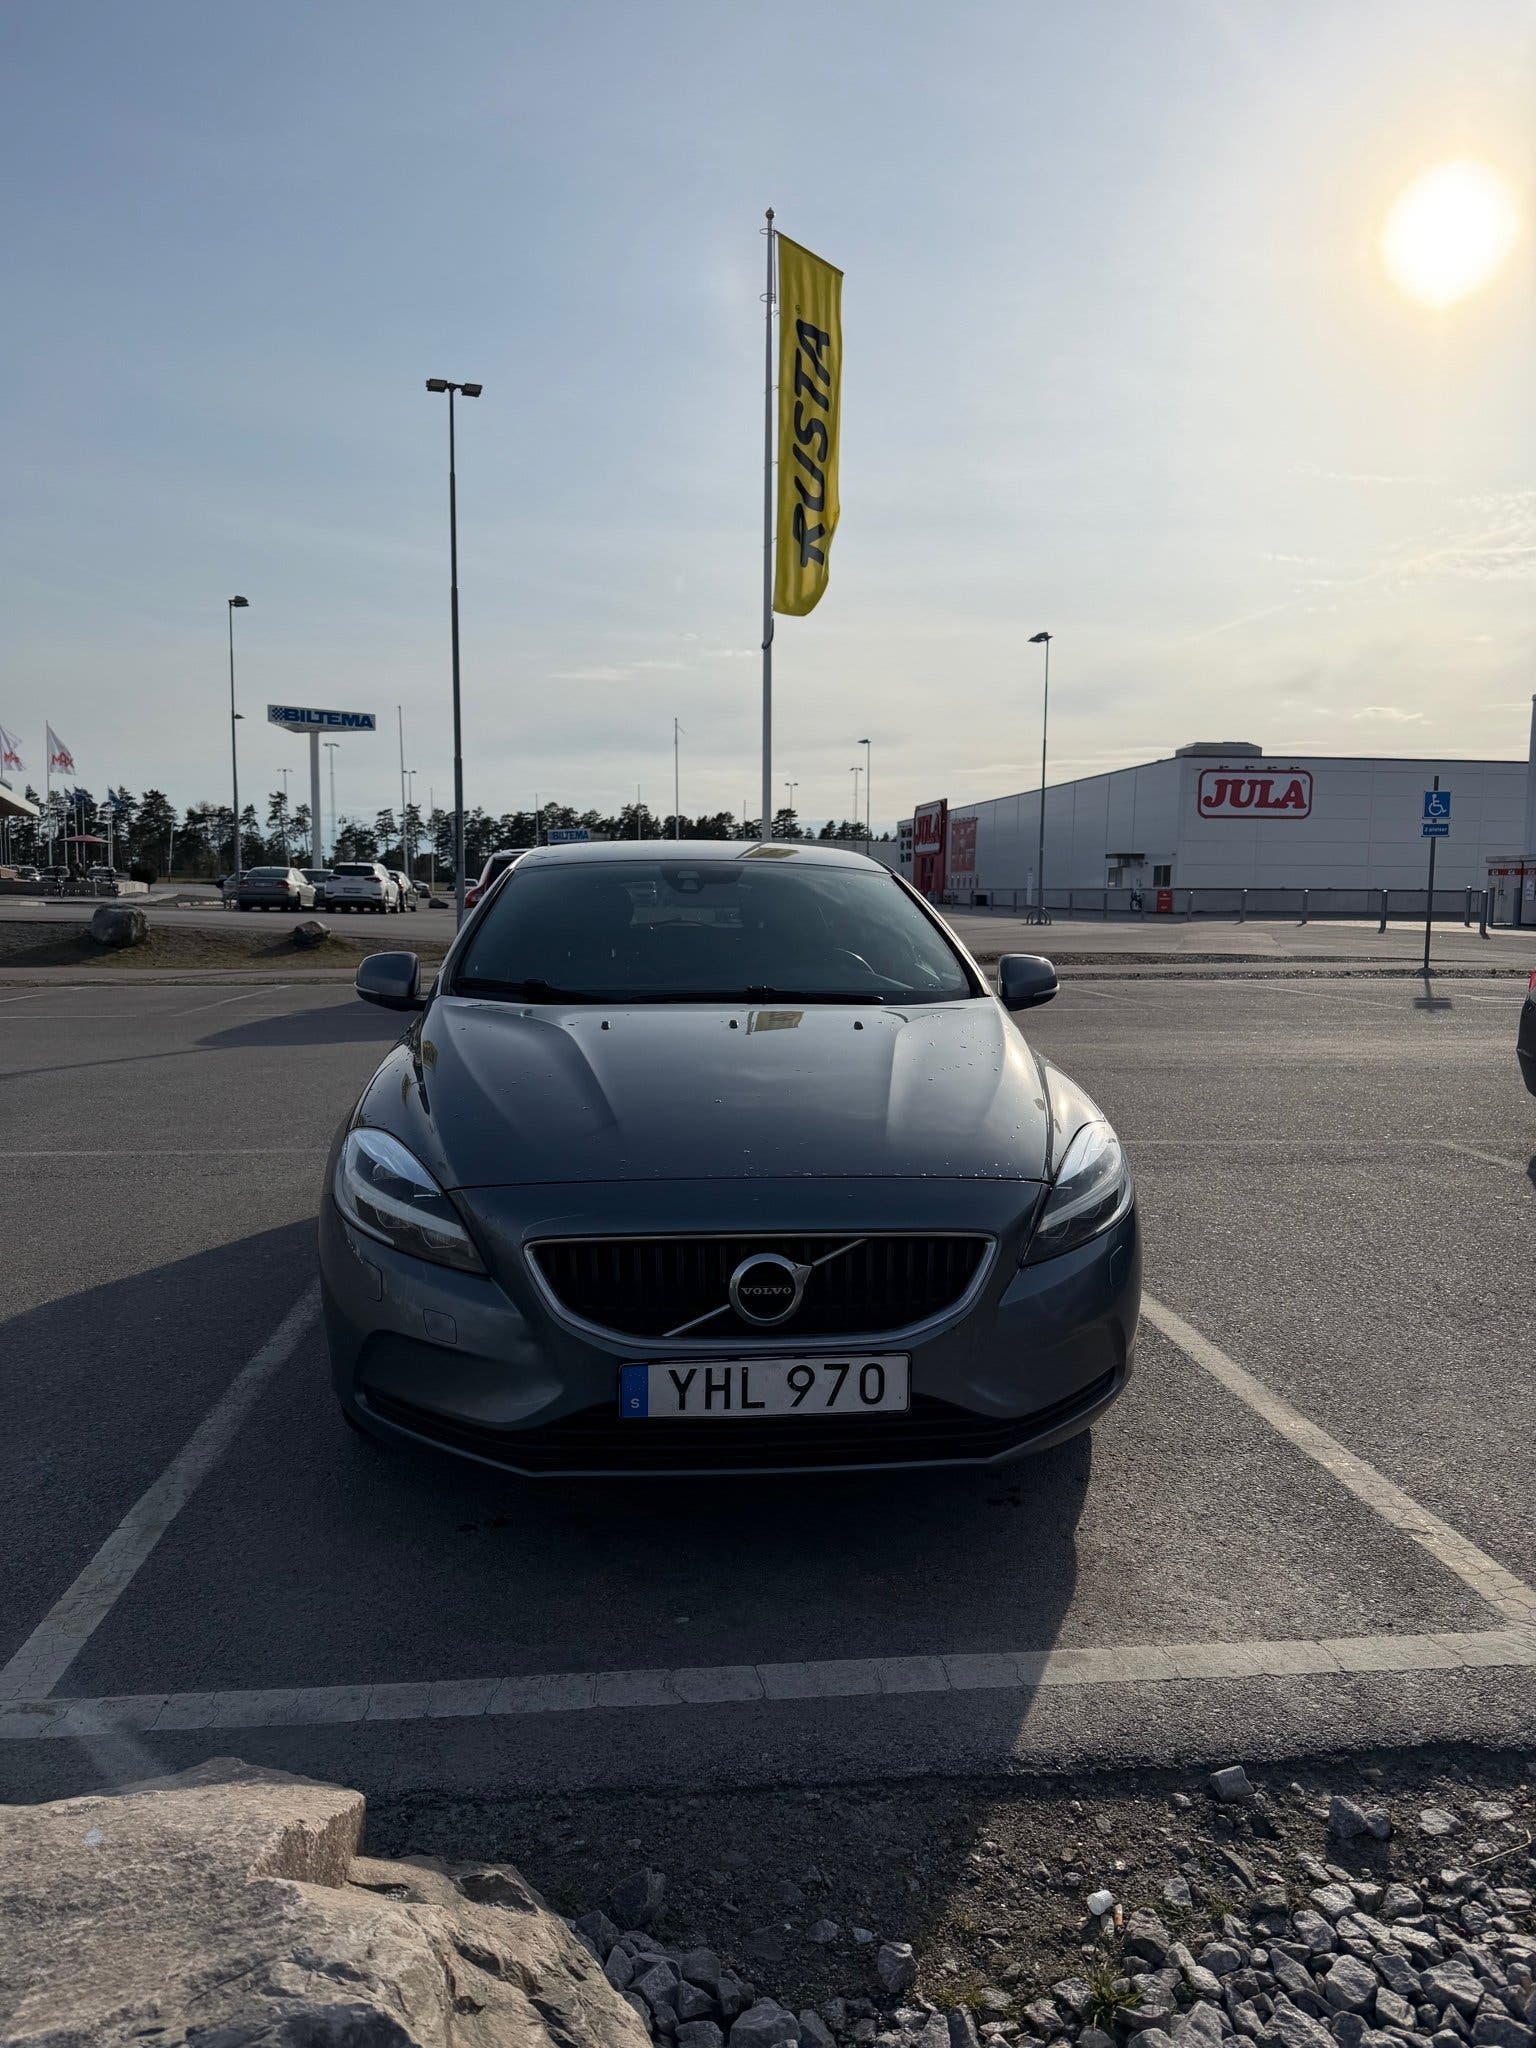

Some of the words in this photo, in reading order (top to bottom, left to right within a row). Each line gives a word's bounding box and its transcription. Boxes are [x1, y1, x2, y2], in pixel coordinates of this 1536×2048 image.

[792, 318, 831, 568] RUSTA
[284, 707, 374, 729] BILTEMA
[1202, 779, 1307, 809] JULA
[551, 830, 590, 841] BILTEMA
[914, 813, 941, 844] JULA
[740, 1286, 792, 1295] VOLVO
[668, 1366, 766, 1411] YHL
[786, 1363, 886, 1408] 970
[629, 1397, 641, 1409] S
